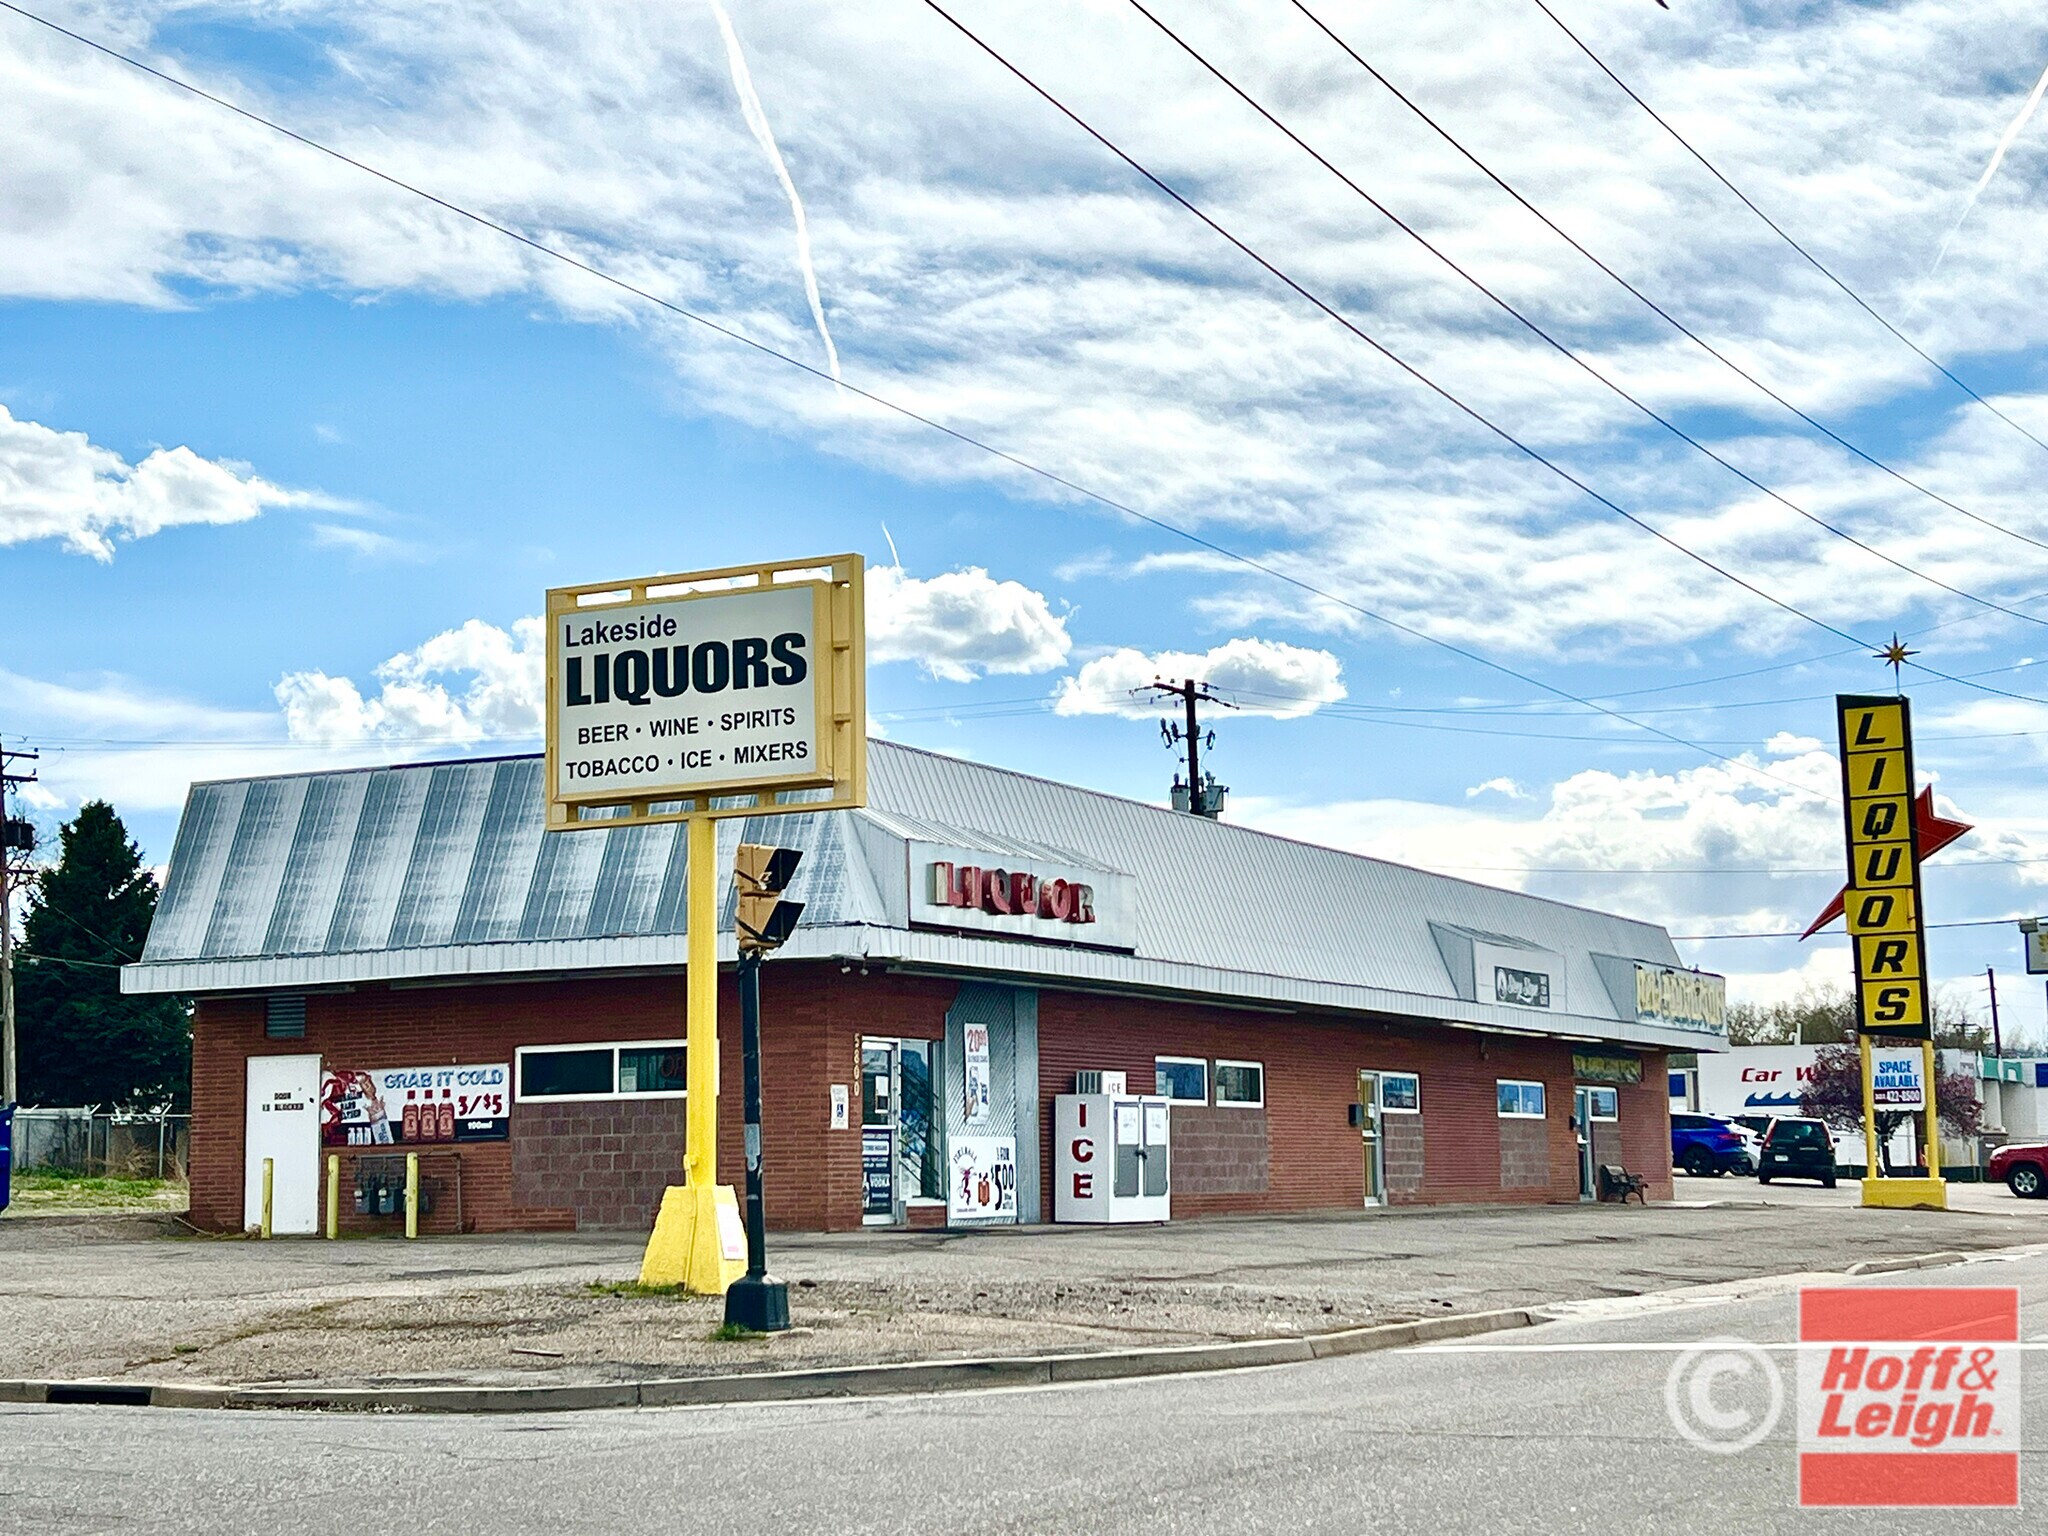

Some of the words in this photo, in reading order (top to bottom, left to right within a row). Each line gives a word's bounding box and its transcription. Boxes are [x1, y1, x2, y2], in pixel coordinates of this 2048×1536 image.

[565, 614, 677, 647] Lakeside
[566, 632, 807, 706] LIQUORS
[578, 723, 629, 745] BEER
[650, 716, 699, 737] WINE
[720, 707, 796, 731] SPIRITS
[565, 754, 660, 779] TOBACCO
[680, 749, 712, 769] ICE
[733, 740, 808, 765] MIXERS
[1854, 712, 1910, 1022] LIQUORS
[933, 861, 1096, 924] LIQUOR
[384, 1071, 433, 1089] GRAB
[437, 1070, 455, 1087] IT
[457, 1068, 504, 1086] COLD
[1741, 1067, 1782, 1082] Car
[1874, 1074, 1919, 1087] AVAILABLE
[1878, 1060, 1912, 1073] SPACE
[458, 1092, 503, 1117] 3/$5
[1108, 1082, 1121, 1094] ICE
[1071, 1103, 1094, 1199] ICE
